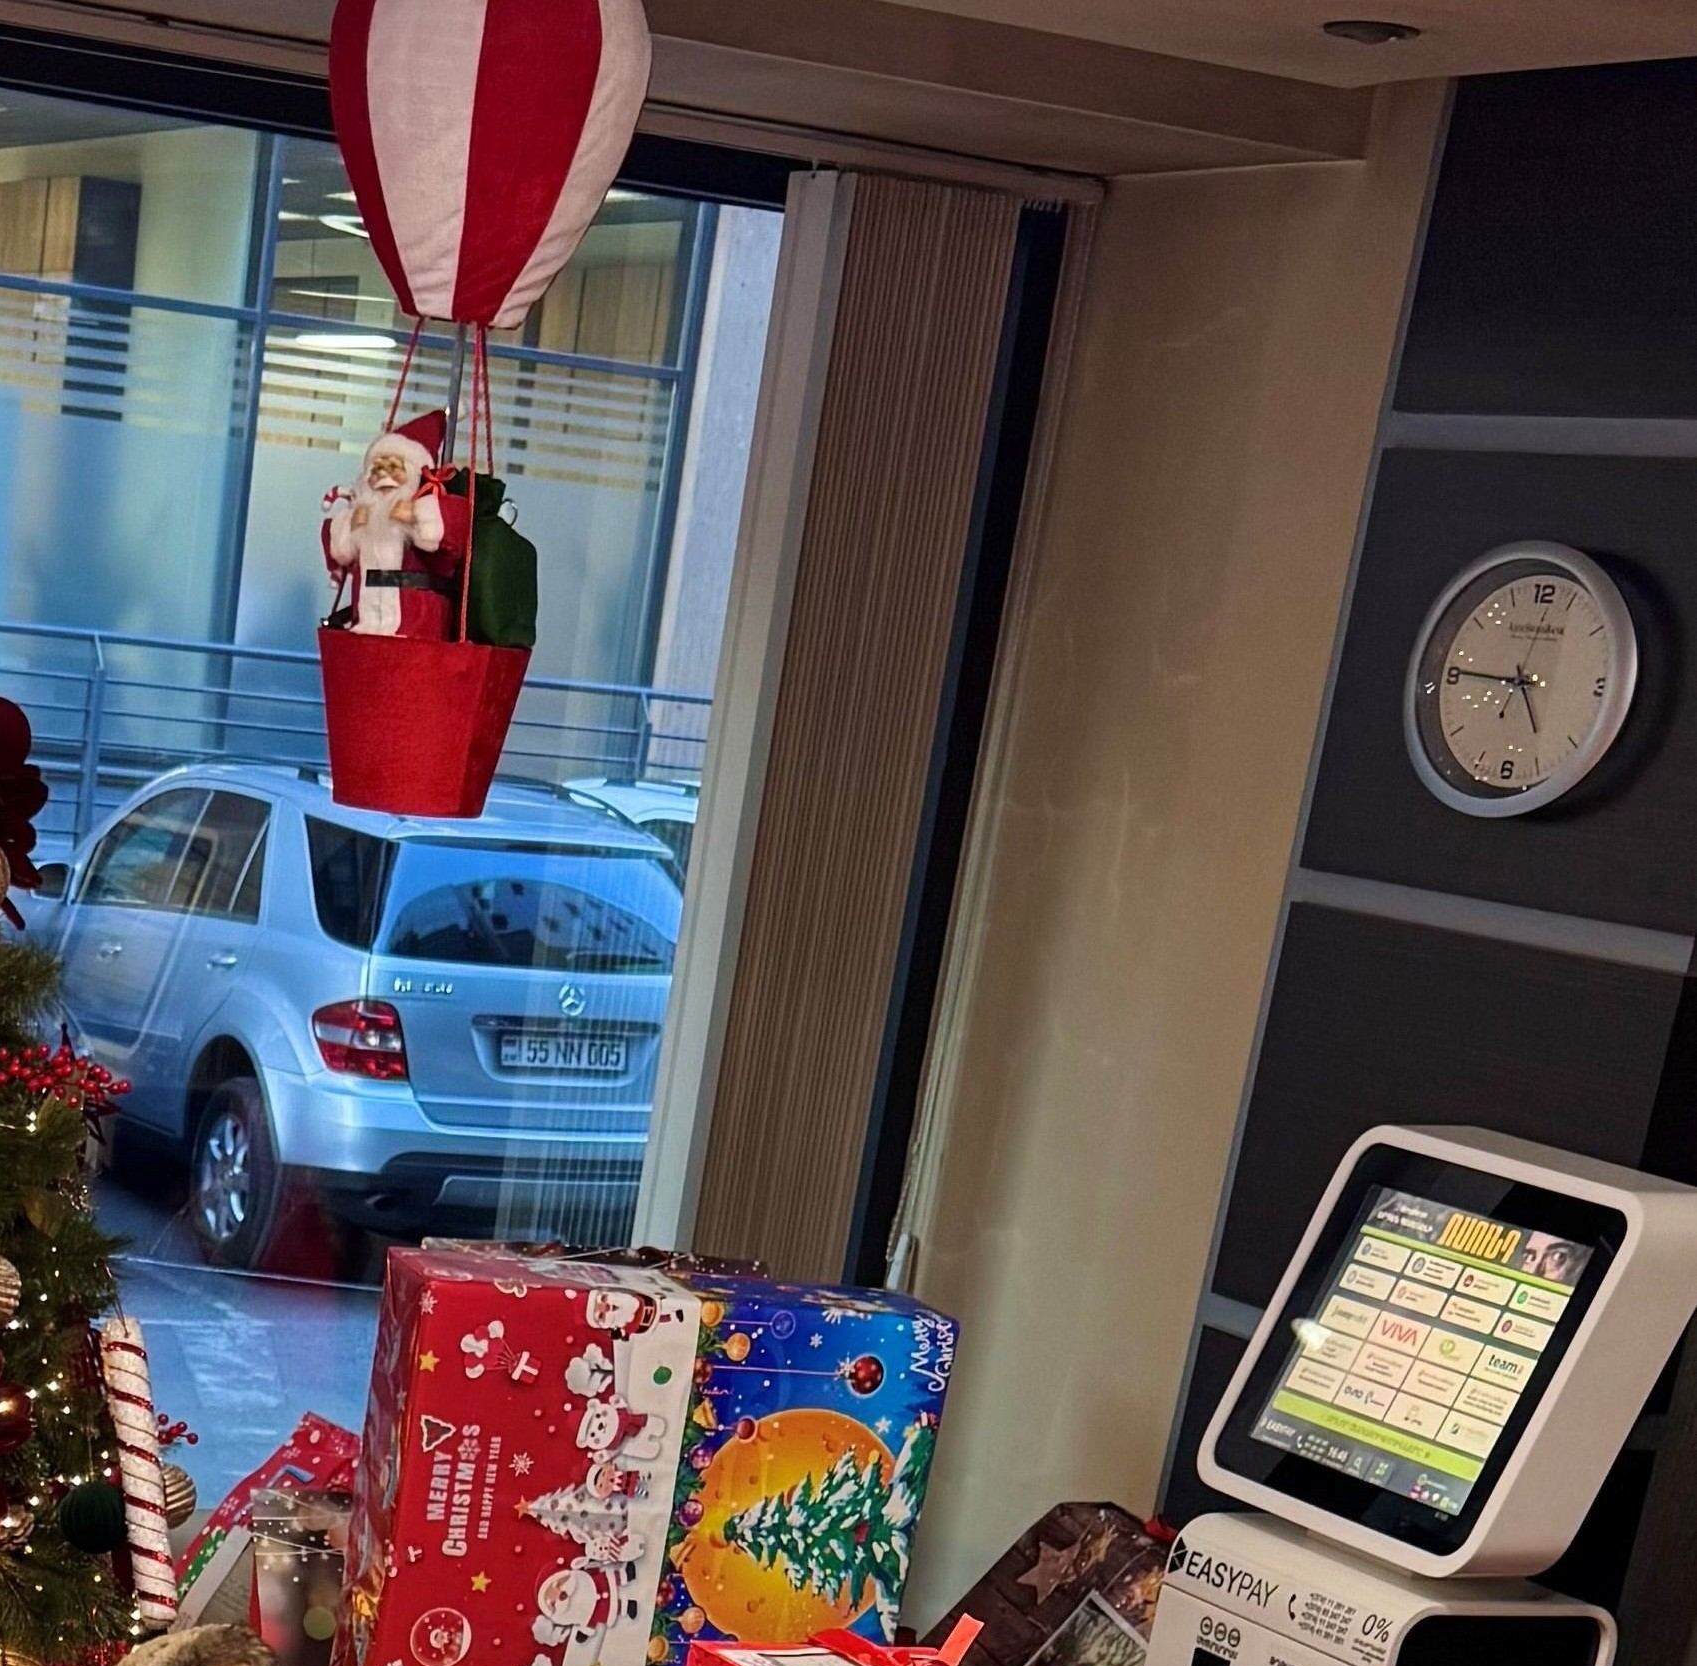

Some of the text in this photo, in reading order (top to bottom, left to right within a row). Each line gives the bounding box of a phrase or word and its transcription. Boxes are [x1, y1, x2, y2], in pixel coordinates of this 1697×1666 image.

[1534, 583, 1556, 604] 12
[1446, 666, 1461, 685] 9
[1500, 760, 1515, 780] 6
[526, 1040, 550, 1064] 55
[554, 1041, 583, 1066] NN
[1381, 1319, 1419, 1347] VIVA
[909, 1309, 946, 1392] Merry
[1487, 1353, 1519, 1374] team
[426, 1450, 453, 1521] MERRY
[1185, 1550, 1280, 1609] EASYPAY
[1361, 1613, 1395, 1644] 0%
